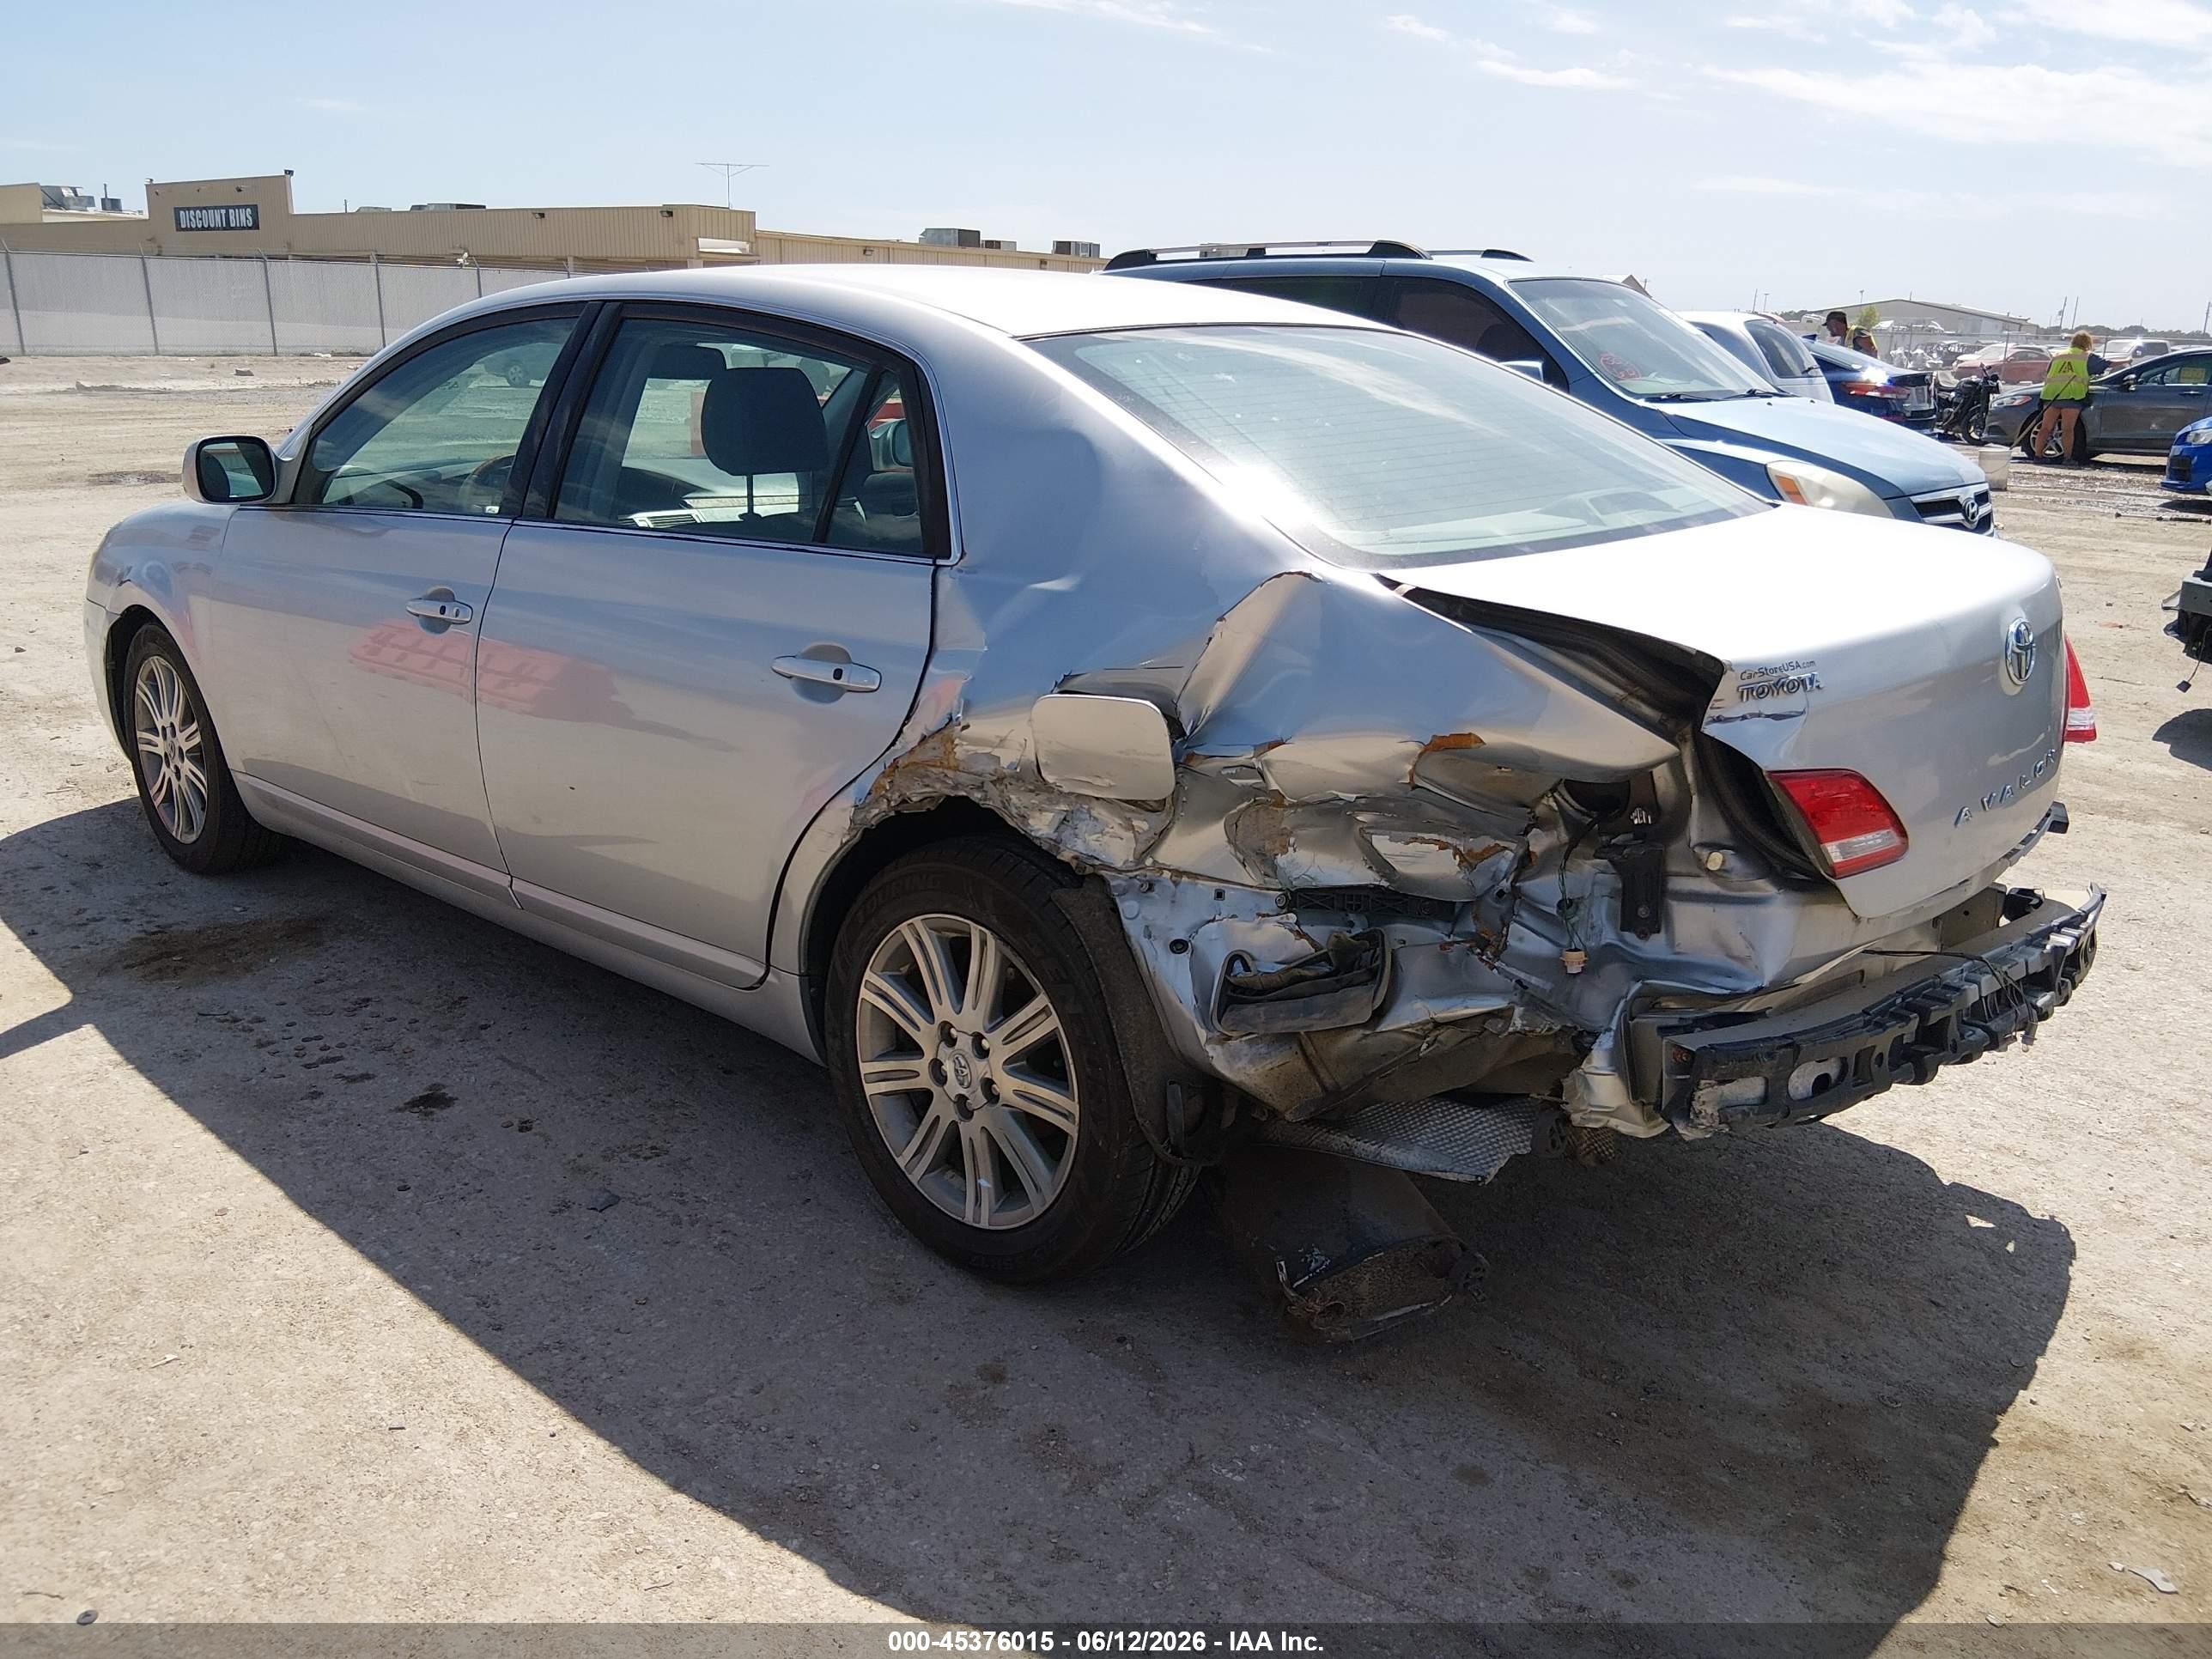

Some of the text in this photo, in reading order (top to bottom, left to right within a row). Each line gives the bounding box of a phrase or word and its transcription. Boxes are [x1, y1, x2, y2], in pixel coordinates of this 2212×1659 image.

[179, 208, 253, 228] DISCOUNT BINS
[1741, 659, 1816, 681] CarStoreUSA.com
[1738, 672, 1823, 702] TOYOTA
